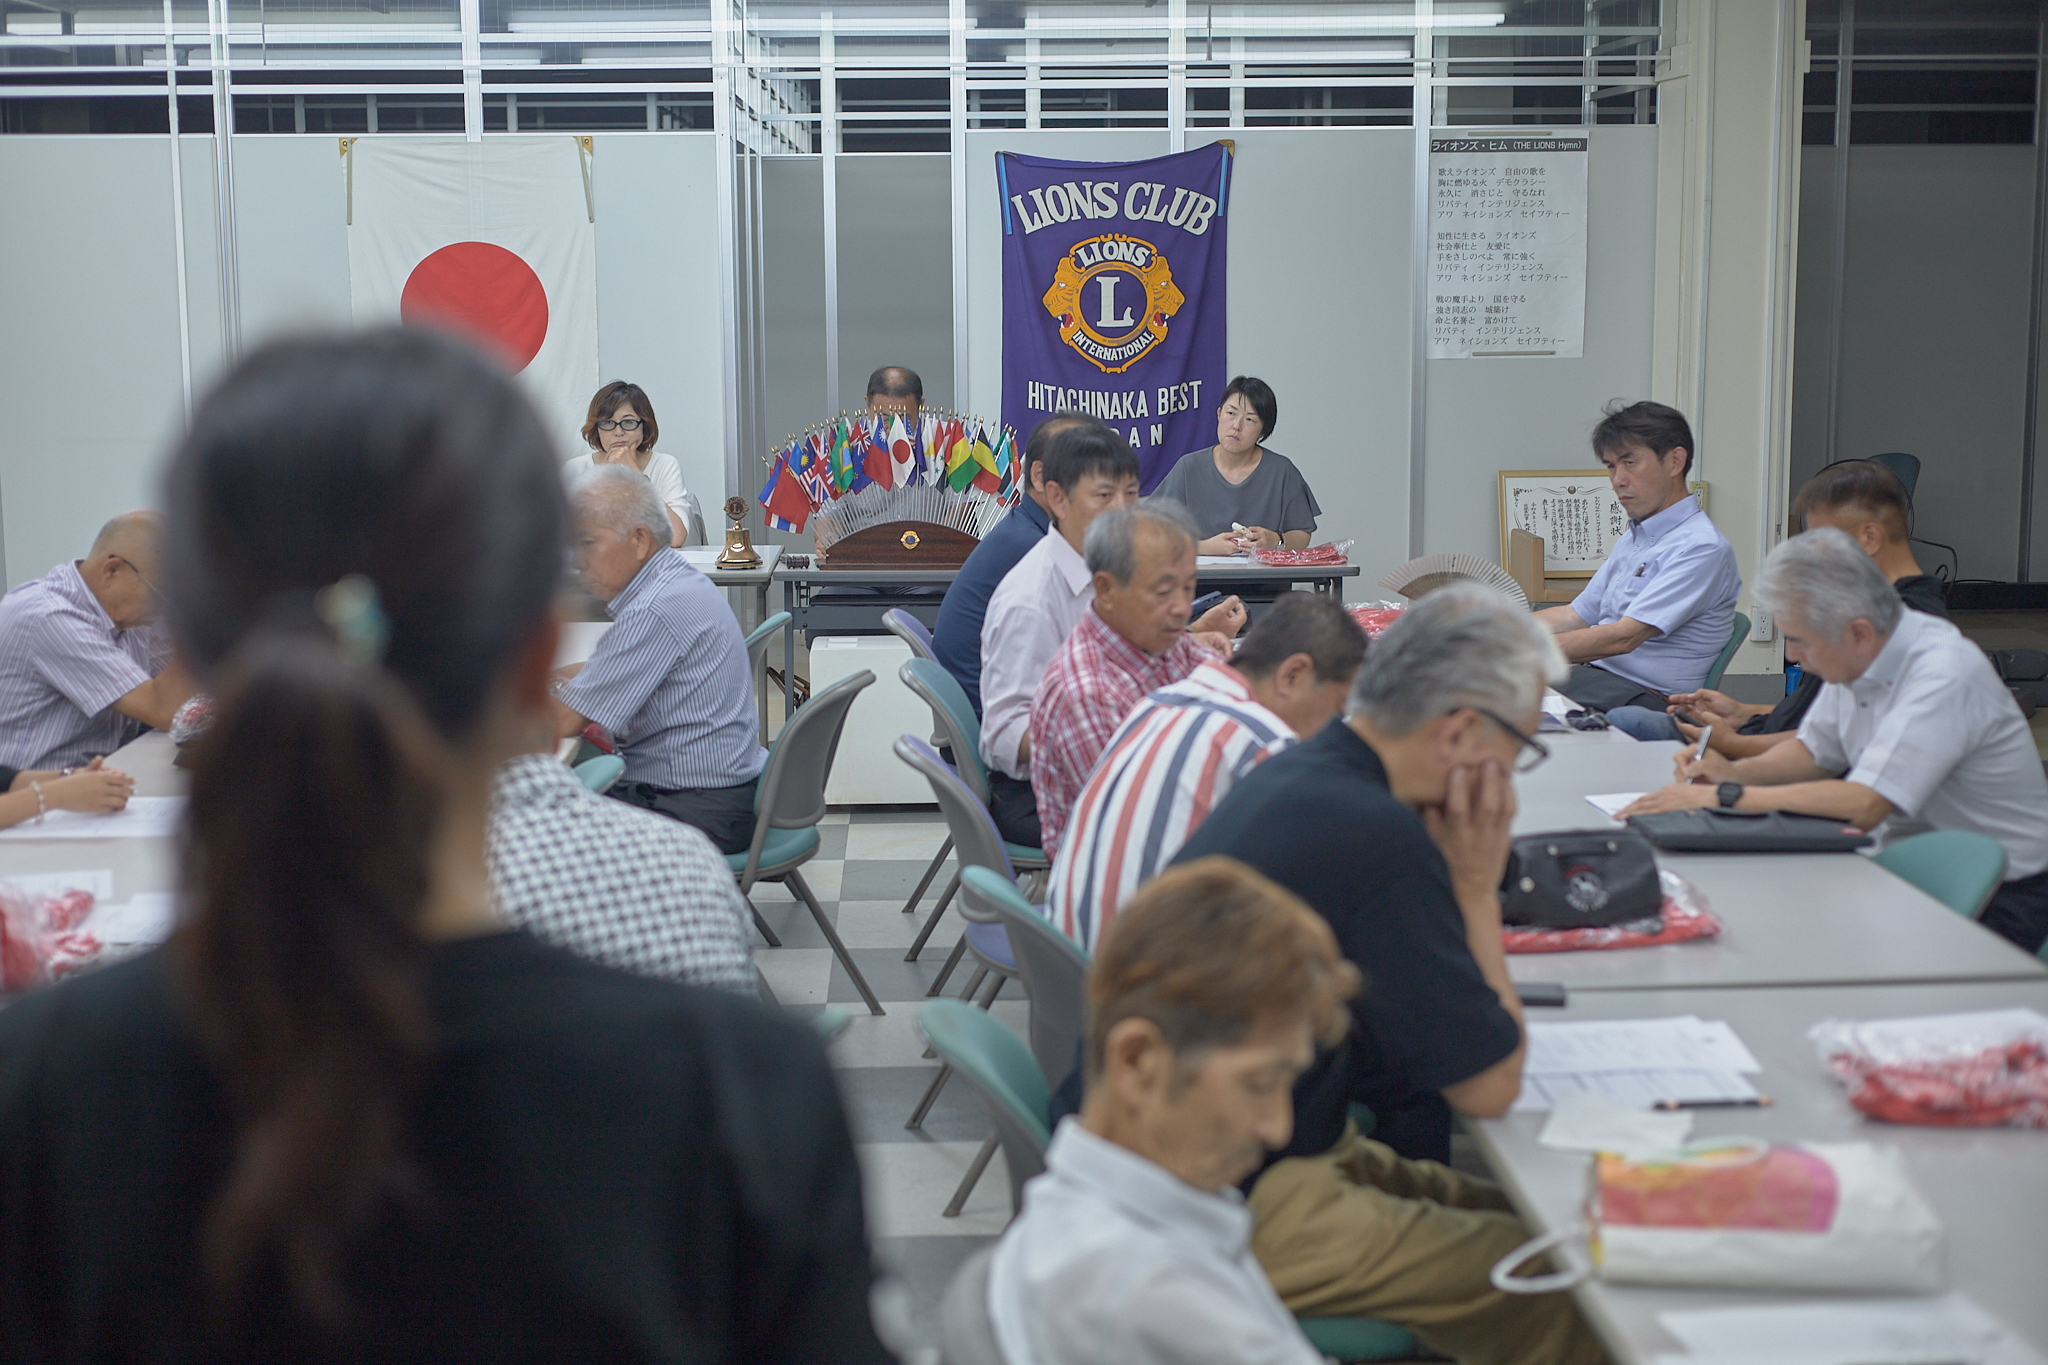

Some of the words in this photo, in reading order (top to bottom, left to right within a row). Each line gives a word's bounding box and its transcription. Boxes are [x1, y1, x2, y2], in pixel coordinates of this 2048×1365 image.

[1431, 140, 1508, 152] ライオンズ・ヒム
[1533, 140, 1556, 150] LIONS
[1558, 139, 1582, 151] Hymn)
[1438, 168, 1497, 177] 歌えライオンズ
[1505, 167, 1546, 176] 自由の歌を
[1437, 179, 1488, 188] 胸に燃ゆる火
[1495, 178, 1546, 187] デモクラシー
[1437, 189, 1462, 198] 永久に
[1512, 189, 1546, 198] 守るなれ
[1010, 181, 1119, 235] LIONS
[1124, 181, 1218, 236] CLUB
[1479, 200, 1545, 209] インテリジェンス
[1437, 210, 1454, 219] アワ
[1462, 210, 1513, 219] ネイションズ
[1520, 210, 1570, 219] セイフティー
[1436, 232, 1486, 241] 知性に生きる
[1495, 231, 1537, 240] ライオンズ
[1436, 242, 1477, 251] 社会奉仕と
[1486, 242, 1511, 251] 友愛に
[1075, 241, 1151, 267] LIONS
[1502, 252, 1535, 261] 常に強く
[1477, 263, 1544, 272] インテリジェンス
[1436, 274, 1452, 283] アワ
[1461, 274, 1512, 283] ネイションズ
[1519, 273, 1568, 282] セイフティー
[1095, 276, 1135, 328] L
[1493, 295, 1527, 304] 国を守る
[1435, 316, 1476, 325] 命と名誉と
[1476, 327, 1541, 336] インテリジェンス
[1072, 329, 1156, 362] INTERNATIONAL
[1434, 337, 1450, 345] アワ
[1458, 337, 1509, 346] ネイションズ
[1516, 337, 1566, 346] セイフティー
[1027, 380, 1149, 420] HITACHINAKA
[1157, 380, 1203, 416] BEST
[1609, 500, 1623, 537] 感謝状
